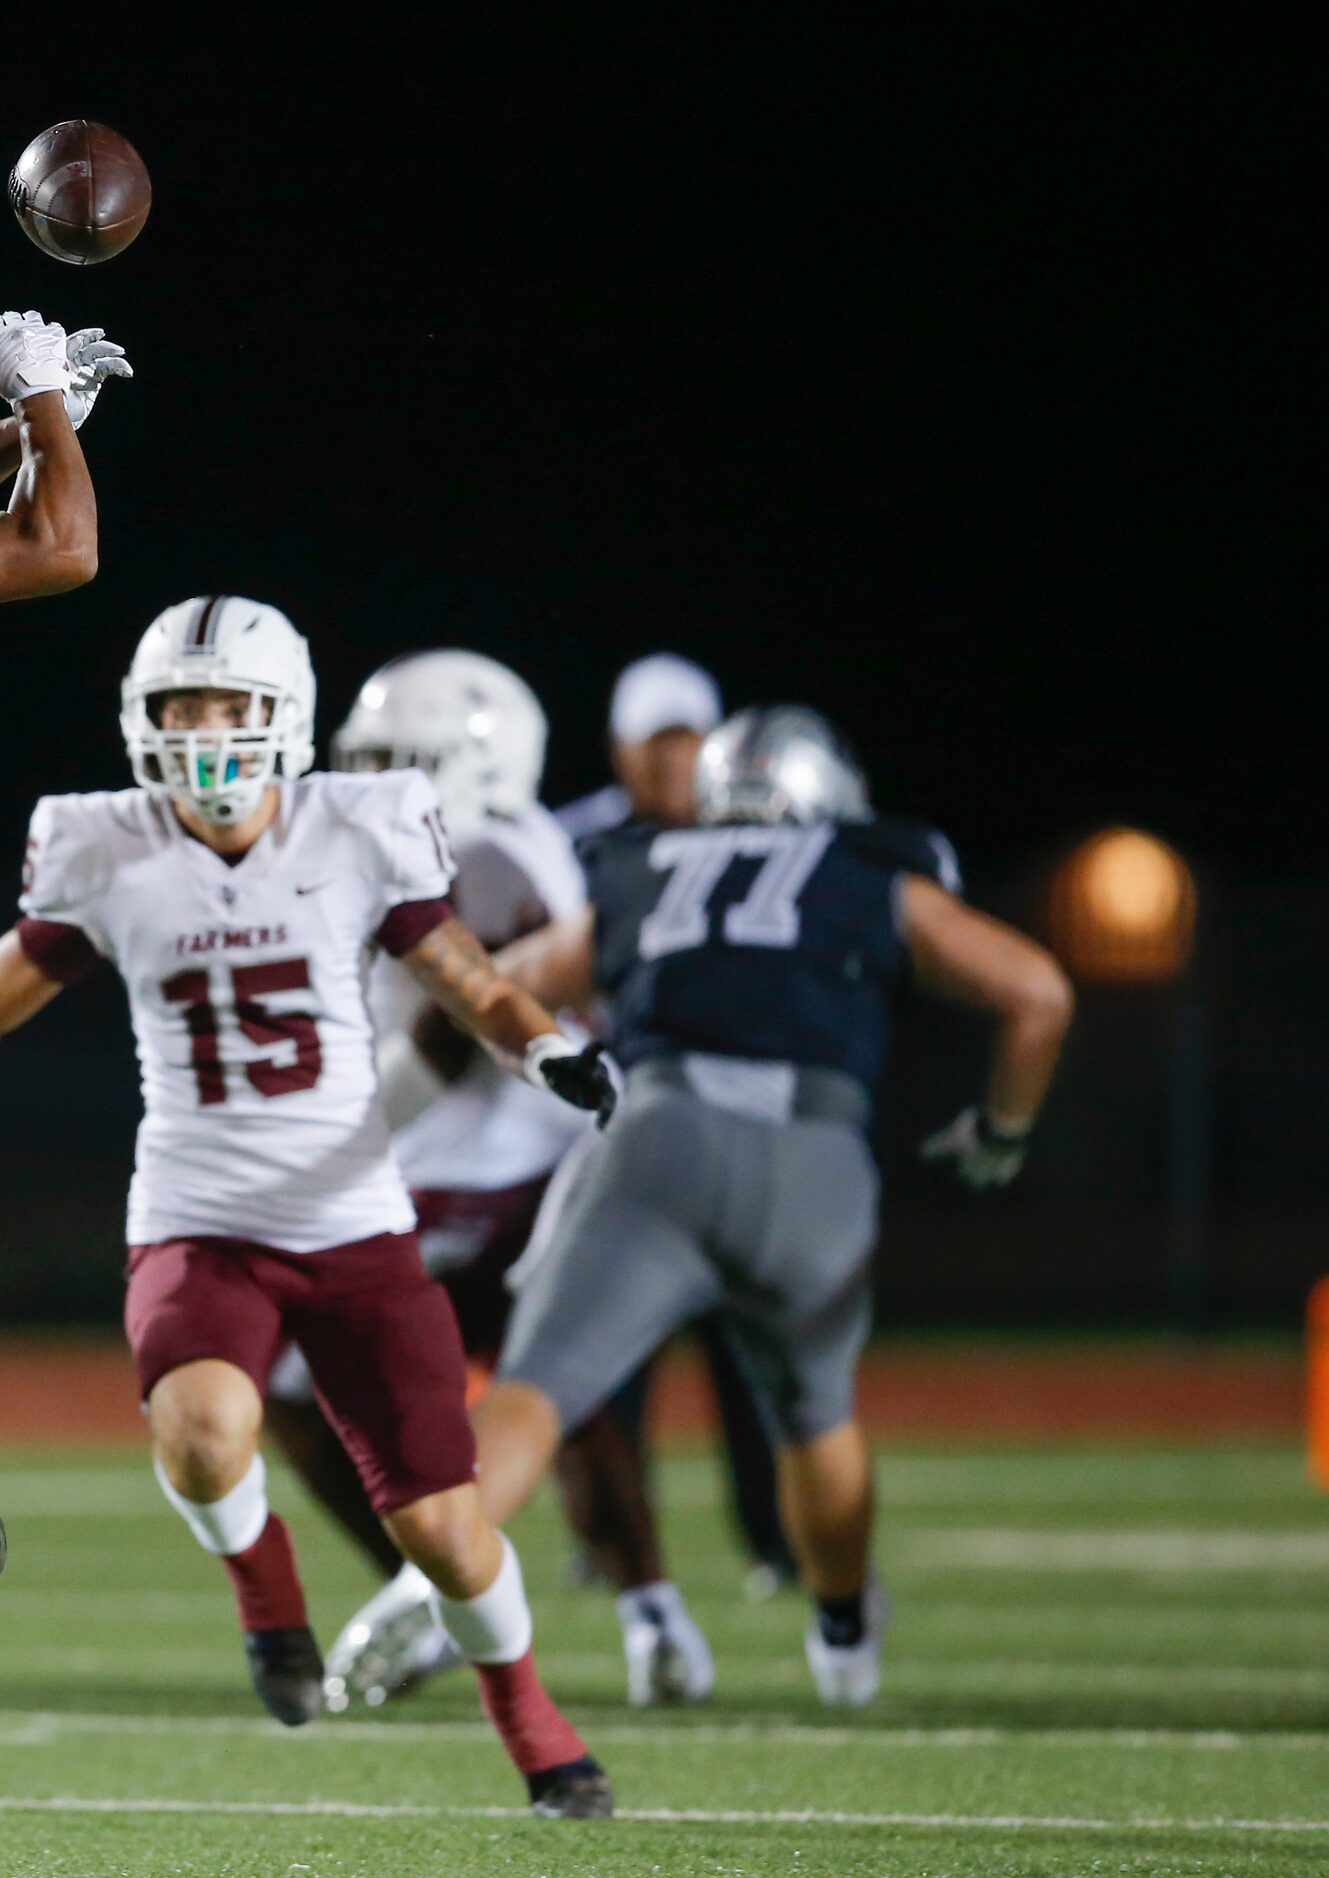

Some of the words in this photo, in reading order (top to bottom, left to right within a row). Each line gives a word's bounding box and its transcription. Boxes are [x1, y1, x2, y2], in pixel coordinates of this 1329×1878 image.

[175, 924, 288, 954] FARMERS
[638, 822, 839, 961] 77
[160, 958, 321, 1105] 15
